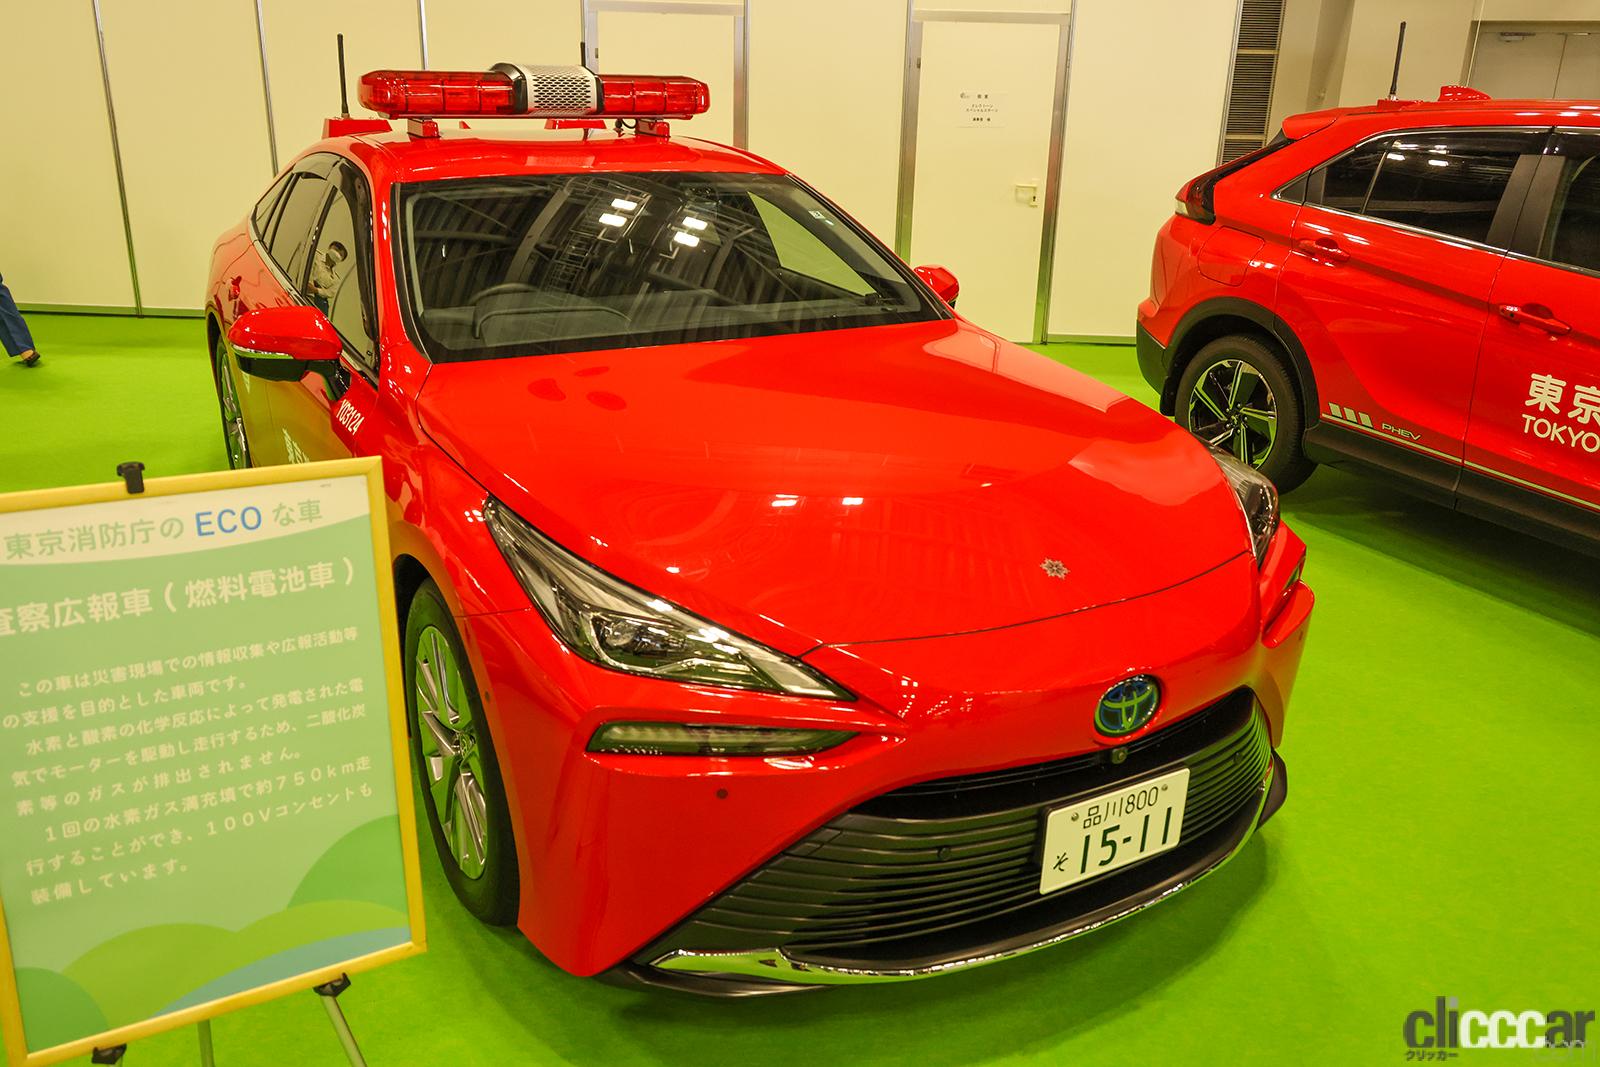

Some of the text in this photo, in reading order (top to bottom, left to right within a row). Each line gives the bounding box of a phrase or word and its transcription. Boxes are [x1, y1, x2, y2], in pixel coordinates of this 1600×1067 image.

[336, 399, 365, 435] Y03124
[1381, 423, 1422, 441] PHEV
[1522, 413, 1600, 452] TOKYO
[4, 499, 323, 560] 東京消防庁の ECO な車
[18, 626, 358, 698] この車は災害現場での情報収集や広報活動等
[3, 675, 247, 729] の支援を目的とした車両です。
[26, 678, 364, 757] 水素と酸素の化学反応によって発電された電
[1053, 807, 1172, 874] そ 15-11
